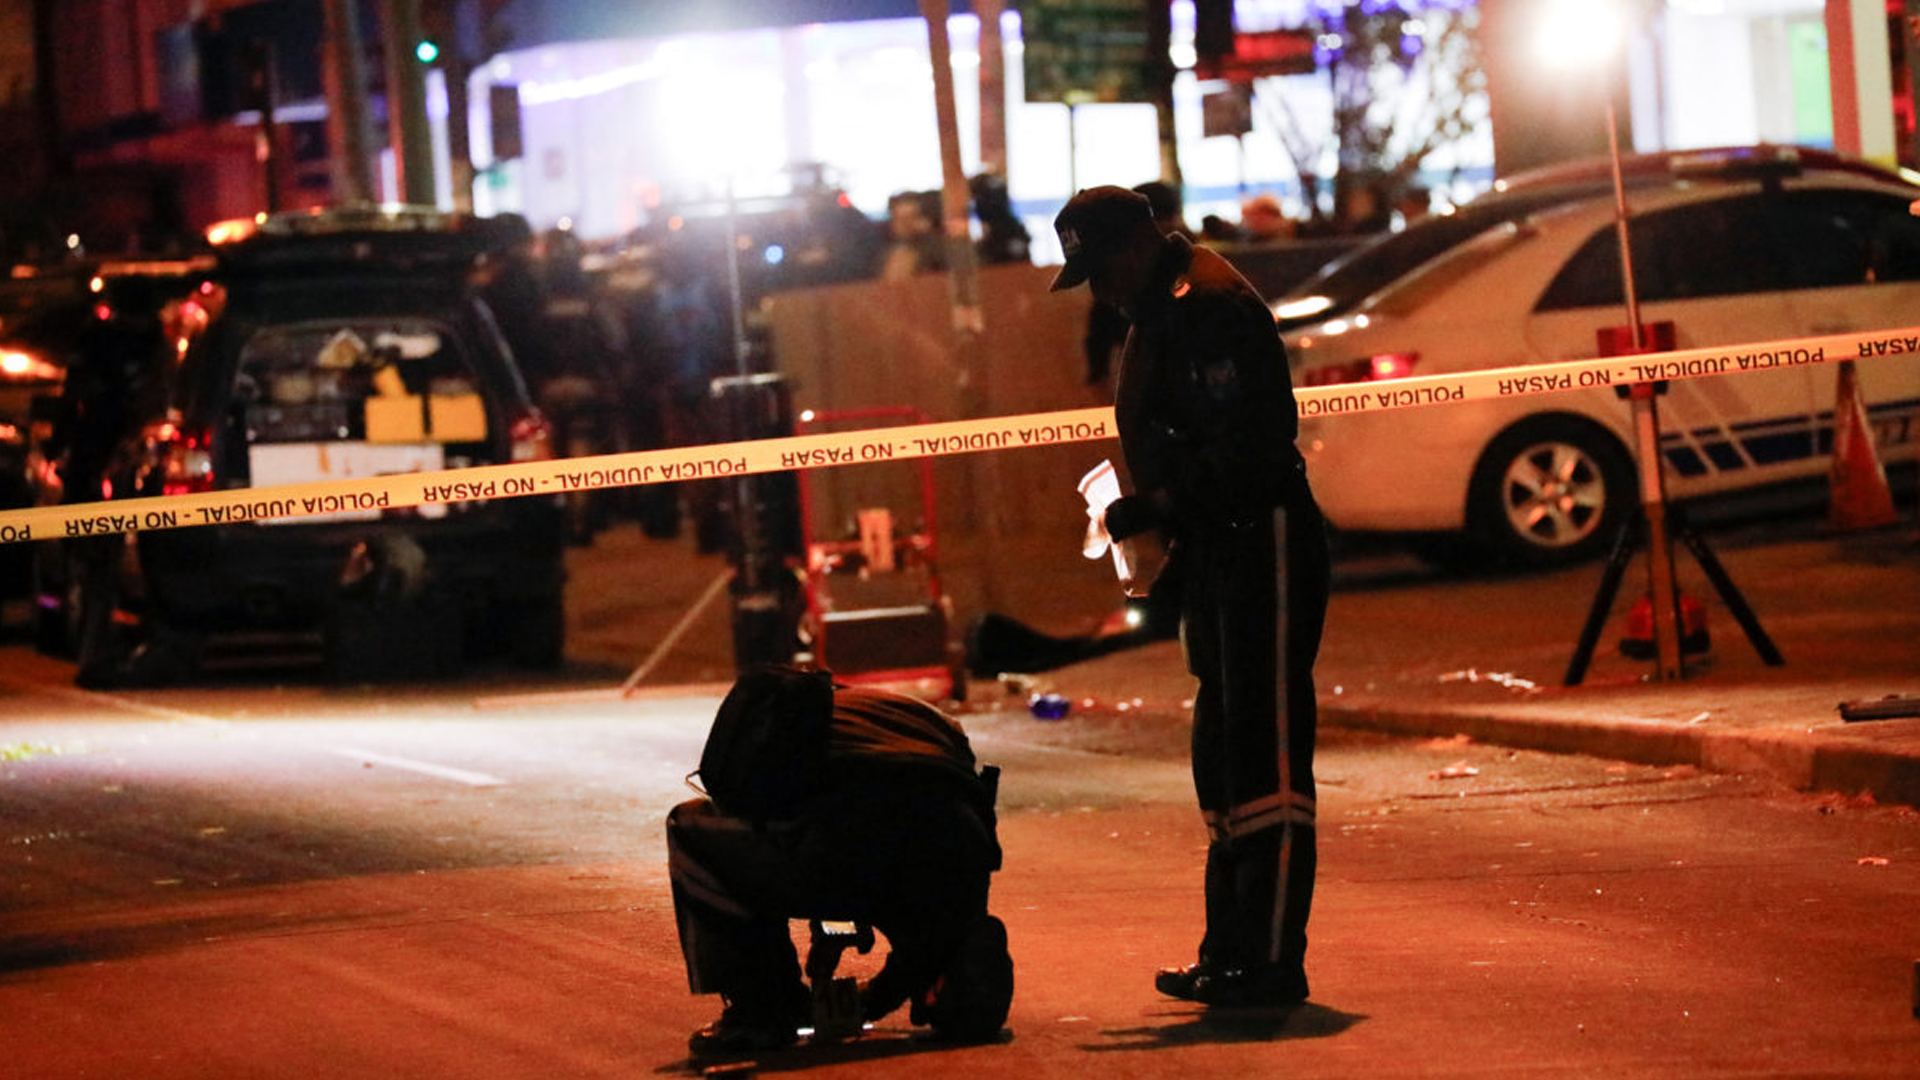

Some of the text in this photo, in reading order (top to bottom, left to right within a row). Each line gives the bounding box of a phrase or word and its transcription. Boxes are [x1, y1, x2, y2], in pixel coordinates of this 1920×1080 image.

[1858, 336, 1920, 357] ASAR
[1630, 357, 1730, 381] JUDICIAL
[1736, 347, 1825, 370] POLICIA
[1498, 373, 1572, 395] PASAR
[1579, 369, 1611, 387] NO
[1300, 385, 1465, 416] POLICIA JUDICI
[913, 430, 1012, 454] JUDICIAL
[1019, 421, 1106, 444] POLICIA
[781, 446, 854, 467] PASAR
[861, 442, 893, 459] NO
[555, 465, 655, 489] JUDICIAL
[660, 457, 747, 480] POLICIA
[423, 480, 496, 501] PASAR
[503, 477, 535, 494] NO
[196, 499, 296, 523] JUDICIAL
[301, 491, 390, 513] POLICIA
[65, 514, 138, 536] PASAR
[145, 510, 177, 528] NO
